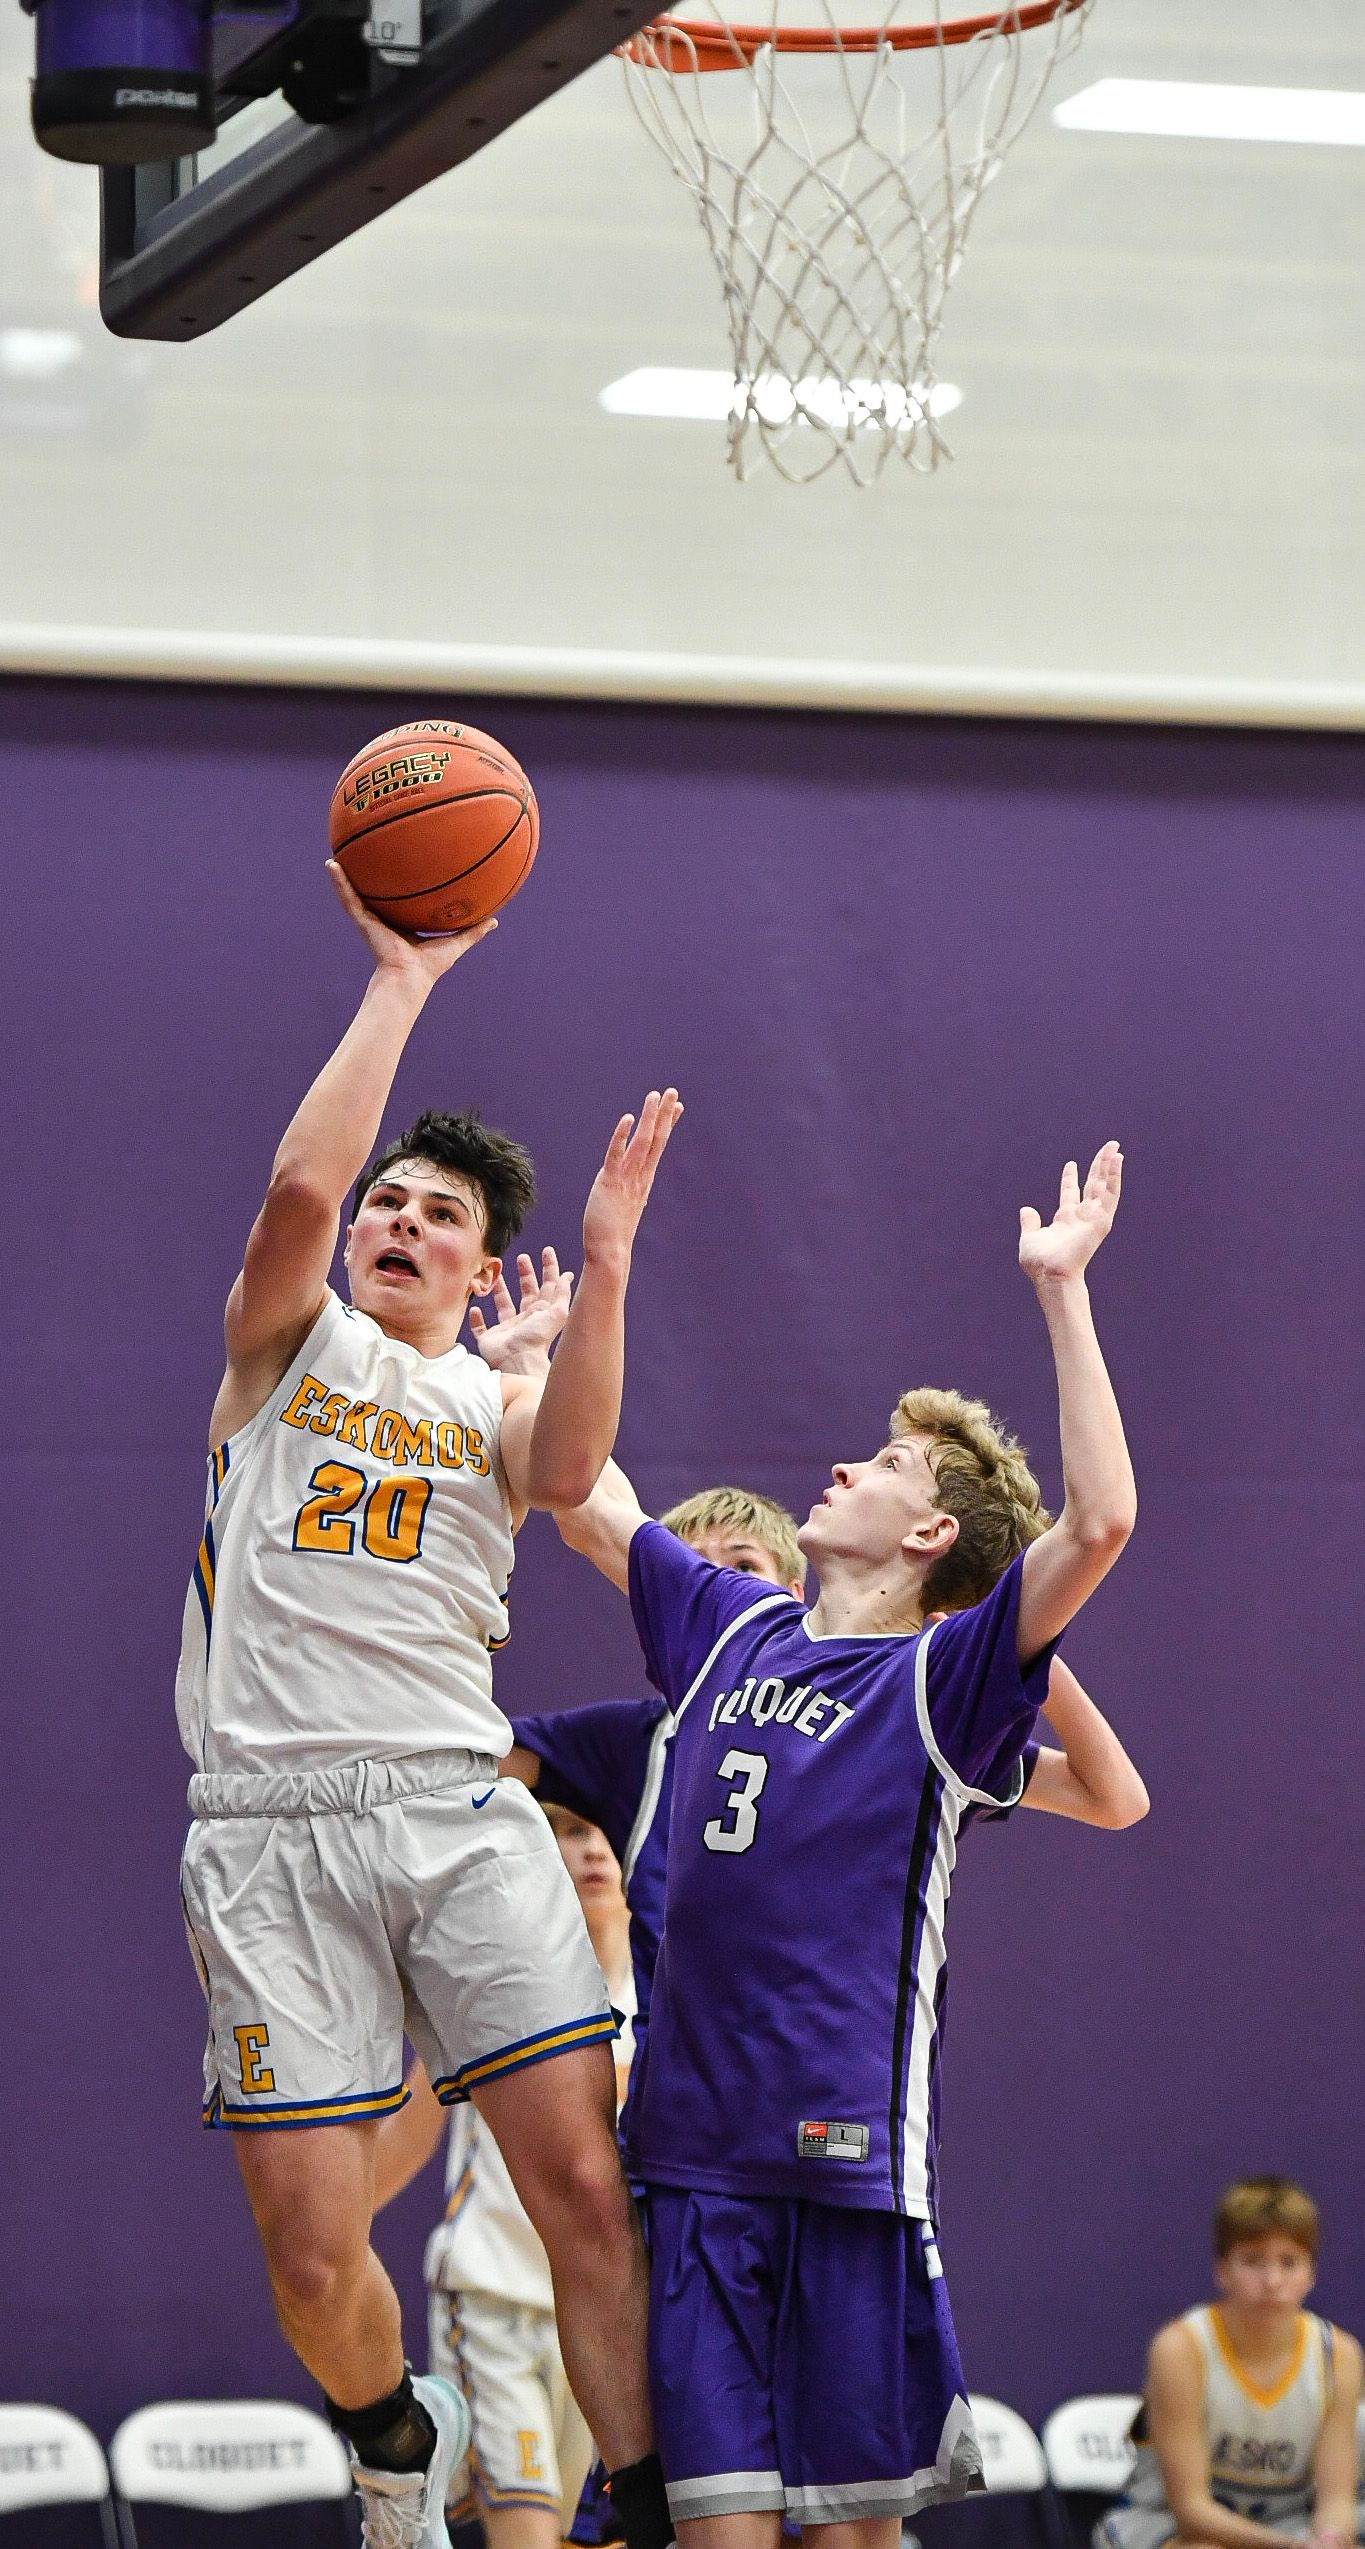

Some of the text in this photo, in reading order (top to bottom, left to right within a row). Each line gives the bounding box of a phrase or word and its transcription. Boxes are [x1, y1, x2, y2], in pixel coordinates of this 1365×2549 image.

[342, 752, 452, 807] LEGACY
[372, 770, 444, 802] 1000
[280, 1373, 491, 1478] ESKOMOS
[292, 1459, 434, 1565] 20
[702, 1748, 769, 1854] 3
[233, 2023, 276, 2095] E
[840, 2128, 849, 2142] L
